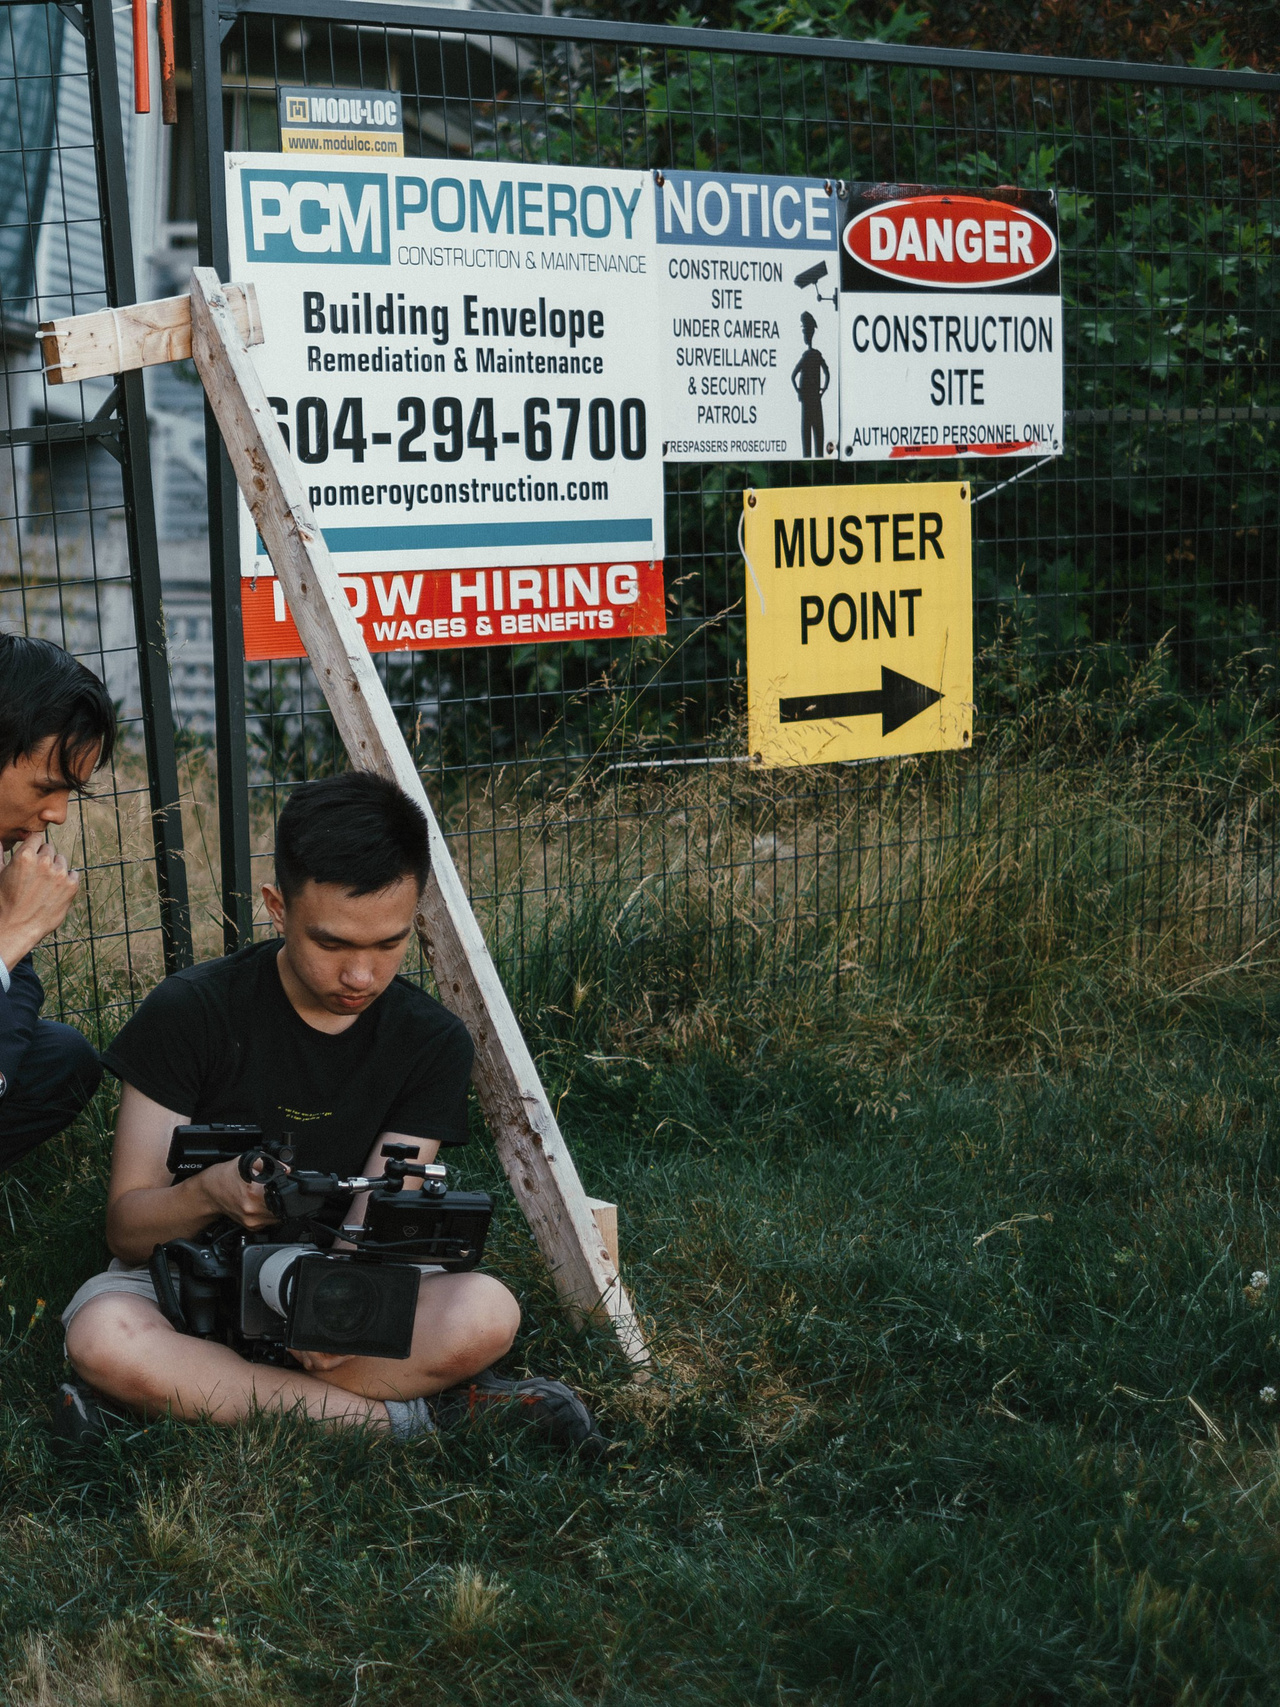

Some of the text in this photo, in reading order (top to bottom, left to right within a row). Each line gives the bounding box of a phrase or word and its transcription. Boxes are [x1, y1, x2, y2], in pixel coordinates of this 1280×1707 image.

[288, 135, 398, 153] www.moduloc.com
[249, 180, 383, 254] PCM
[394, 175, 642, 240] POMEROY
[663, 180, 832, 241] NOTICE
[869, 216, 1035, 265] DANGER
[398, 245, 647, 274] CONSTRUCTION & MAINTENANCE
[668, 258, 783, 283] CONSTRUCTION
[711, 289, 743, 310] SITE
[303, 291, 604, 348] Building Envelope
[673, 318, 780, 339] UNDER CAMERA
[852, 314, 1053, 354] CONSTRUCTION
[307, 345, 604, 374] Remediation & Maintenance
[676, 348, 777, 368] SURVEILLANCE
[687, 376, 767, 396] & SECURITY
[930, 368, 985, 407] SITE
[697, 405, 757, 424] PATROLS
[665, 440, 787, 452] TRESPASSERS PROSECUTED
[852, 424, 1054, 446] AUTHORIZED PERSONNEL ONLY
[308, 475, 608, 513] pomeroyconstruction.com
[774, 512, 945, 569] MUSTER
[451, 564, 640, 617] HIRING
[373, 618, 467, 642] WAGES
[475, 617, 493, 638] &
[500, 609, 615, 636] BENEFITS
[800, 588, 923, 645] POINT
